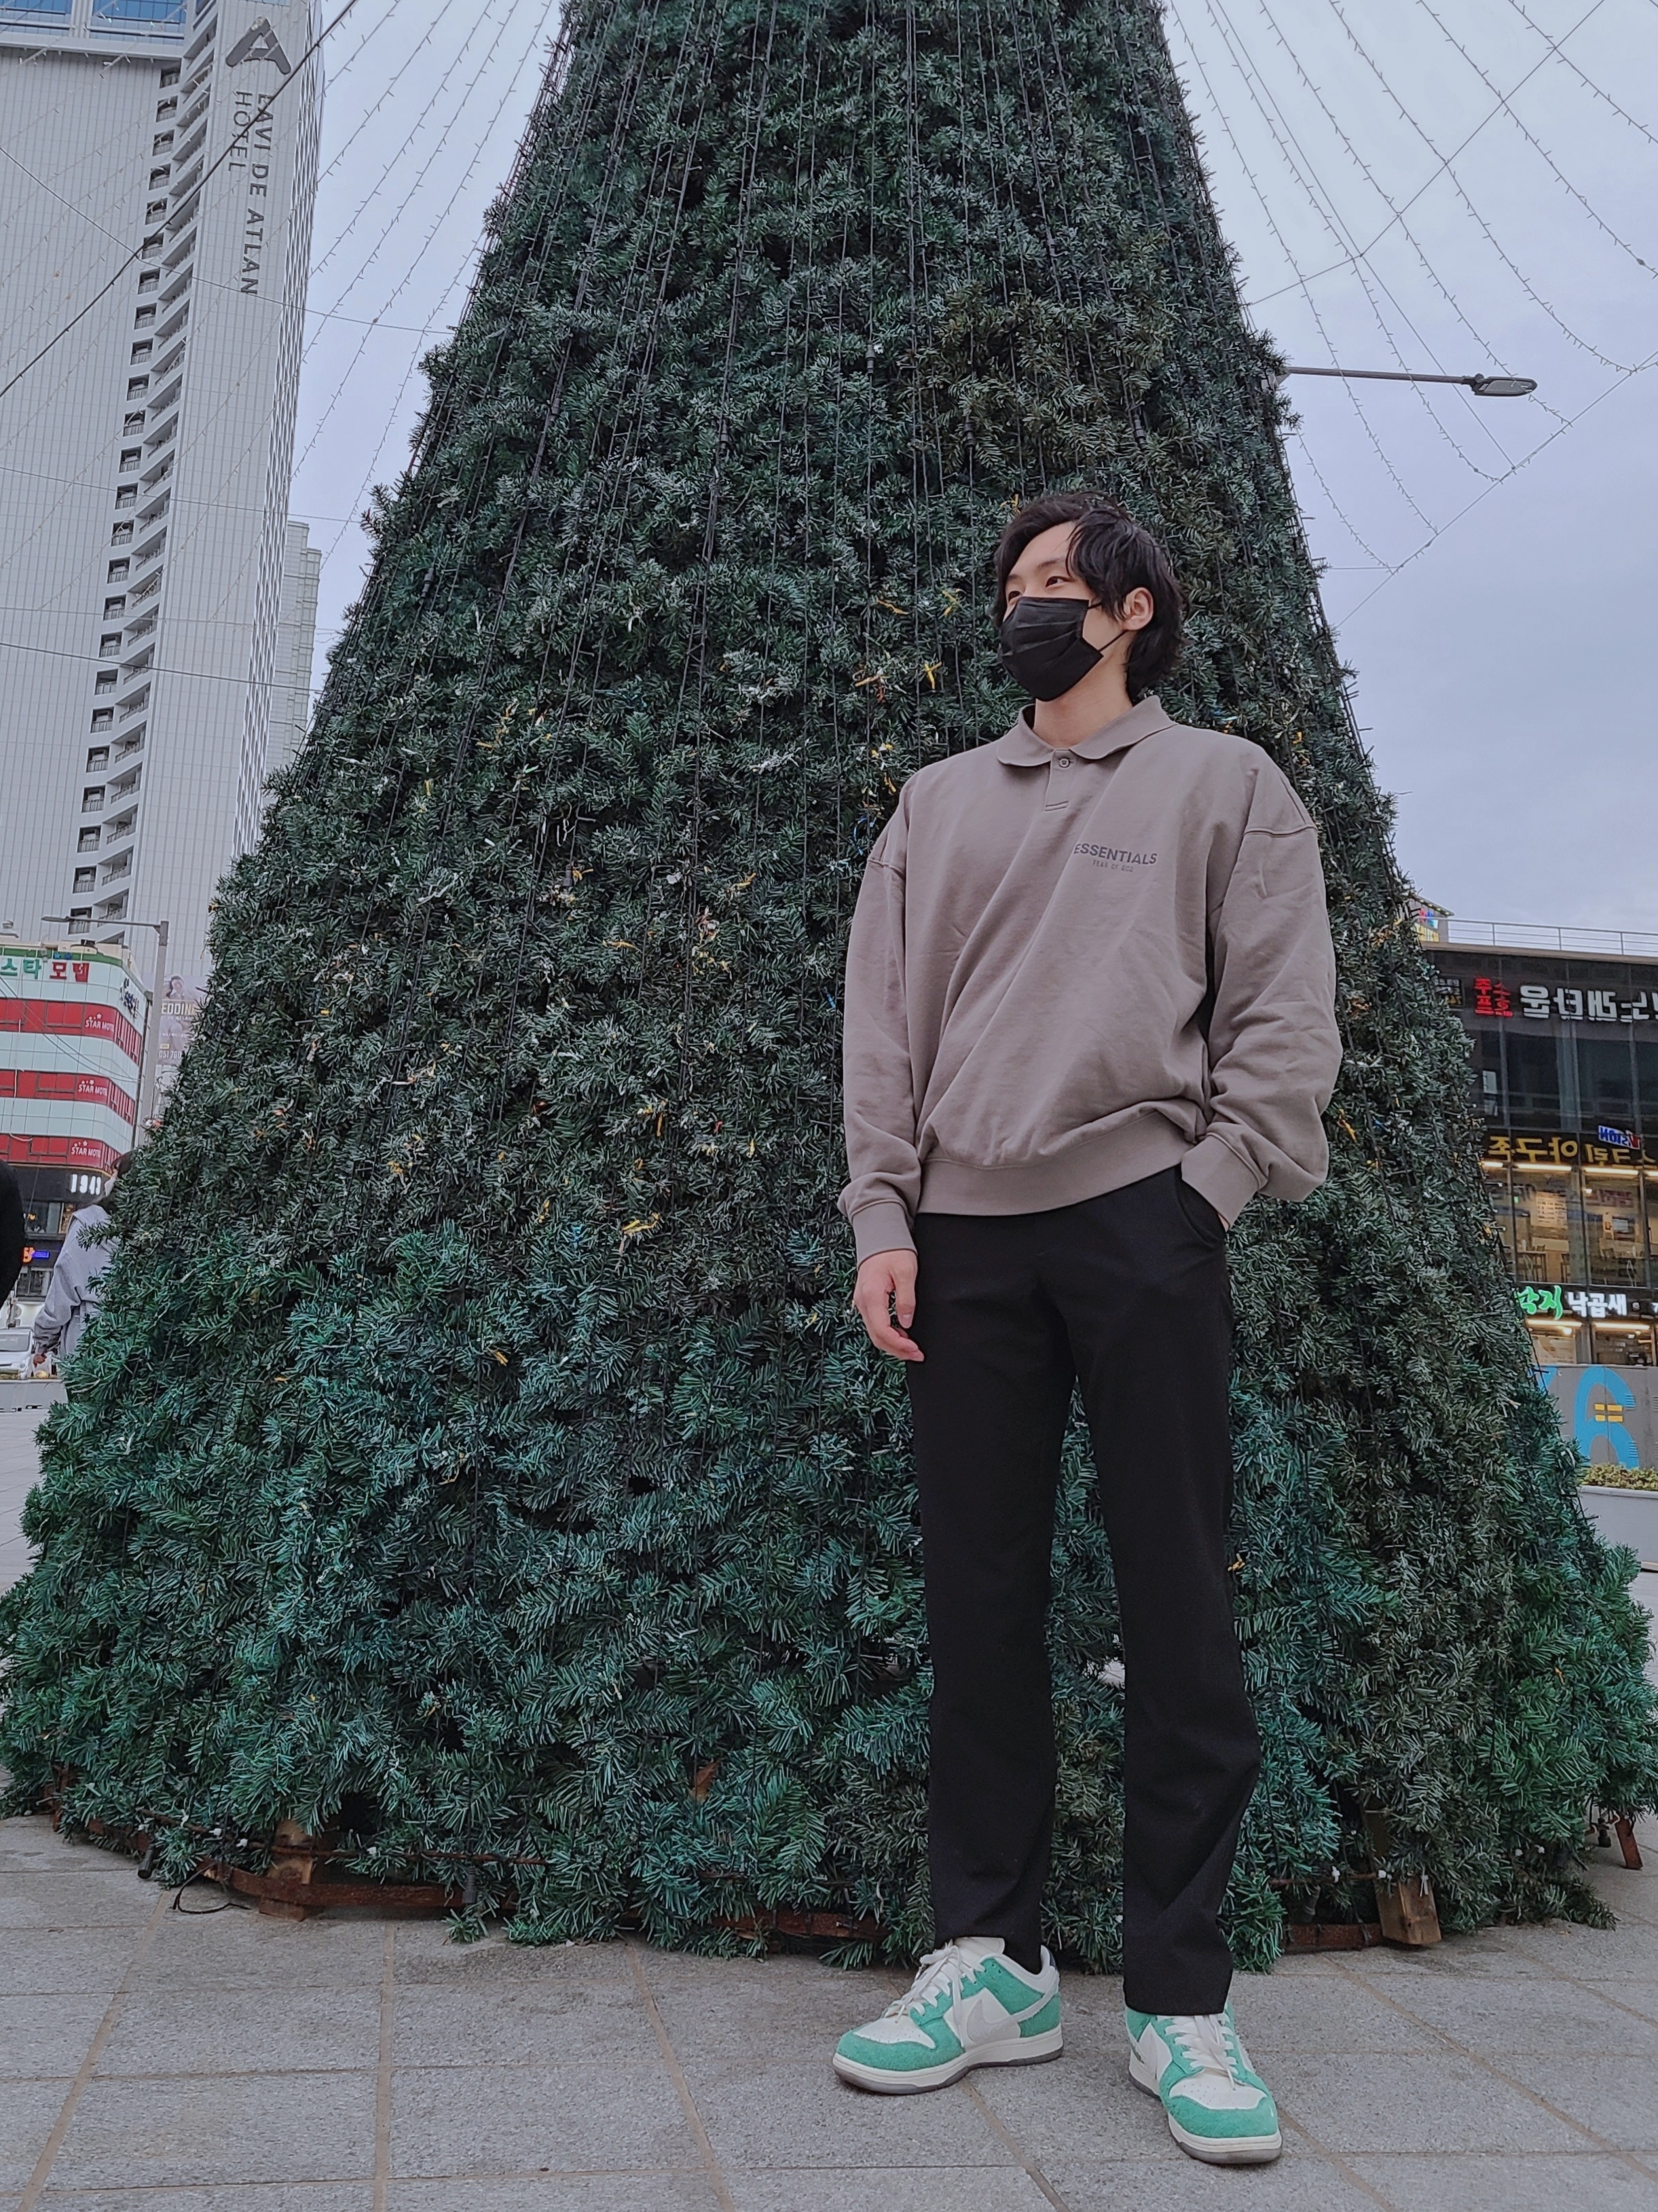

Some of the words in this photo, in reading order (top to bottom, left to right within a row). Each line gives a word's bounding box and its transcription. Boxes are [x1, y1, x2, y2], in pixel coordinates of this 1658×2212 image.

[229, 91, 253, 171] HOTEL
[254, 94, 274, 150] LAVI
[250, 163, 269, 197] DE
[241, 208, 264, 294] ATLAN
[1074, 843, 1157, 865] ESSENTIALS
[1092, 860, 1108, 868] FEAR
[162, 1003, 196, 1015] EDDIN
[86, 1019, 100, 1030] STAR
[78, 1085, 94, 1093] STAR
[71, 1147, 87, 1156] STAR
[1567, 1291, 1627, 1318] 낙곱새
